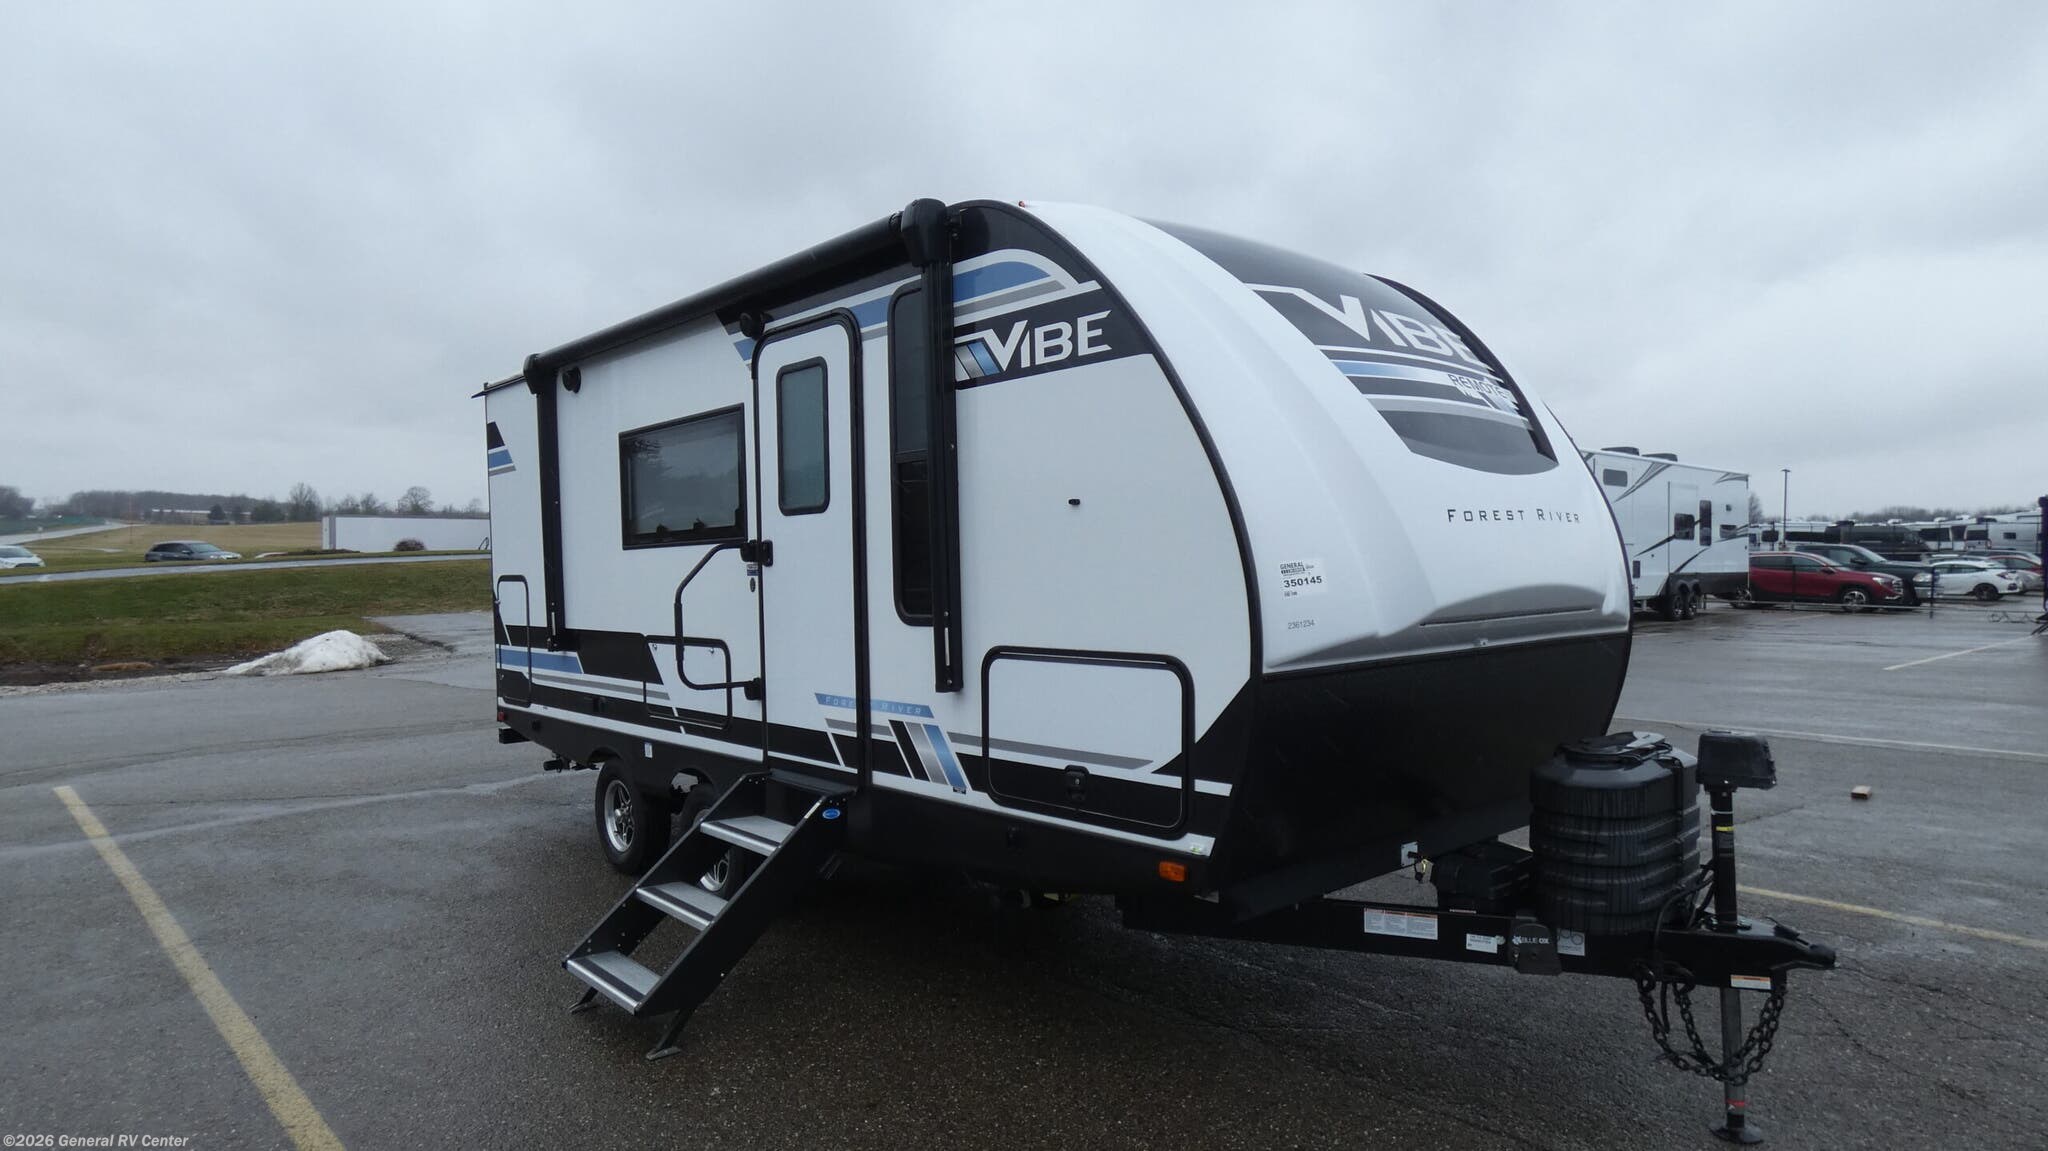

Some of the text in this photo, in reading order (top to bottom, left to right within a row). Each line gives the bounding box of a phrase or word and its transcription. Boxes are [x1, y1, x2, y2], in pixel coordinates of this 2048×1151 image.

[1294, 289, 1488, 367] VIBE
[974, 310, 1112, 372] VIBE
[1447, 508, 1580, 523] FOREST RIVER
[1280, 562, 1304, 570] GENERAL
[1283, 575, 1322, 588] 350145
[880, 702, 921, 715] RIVER
